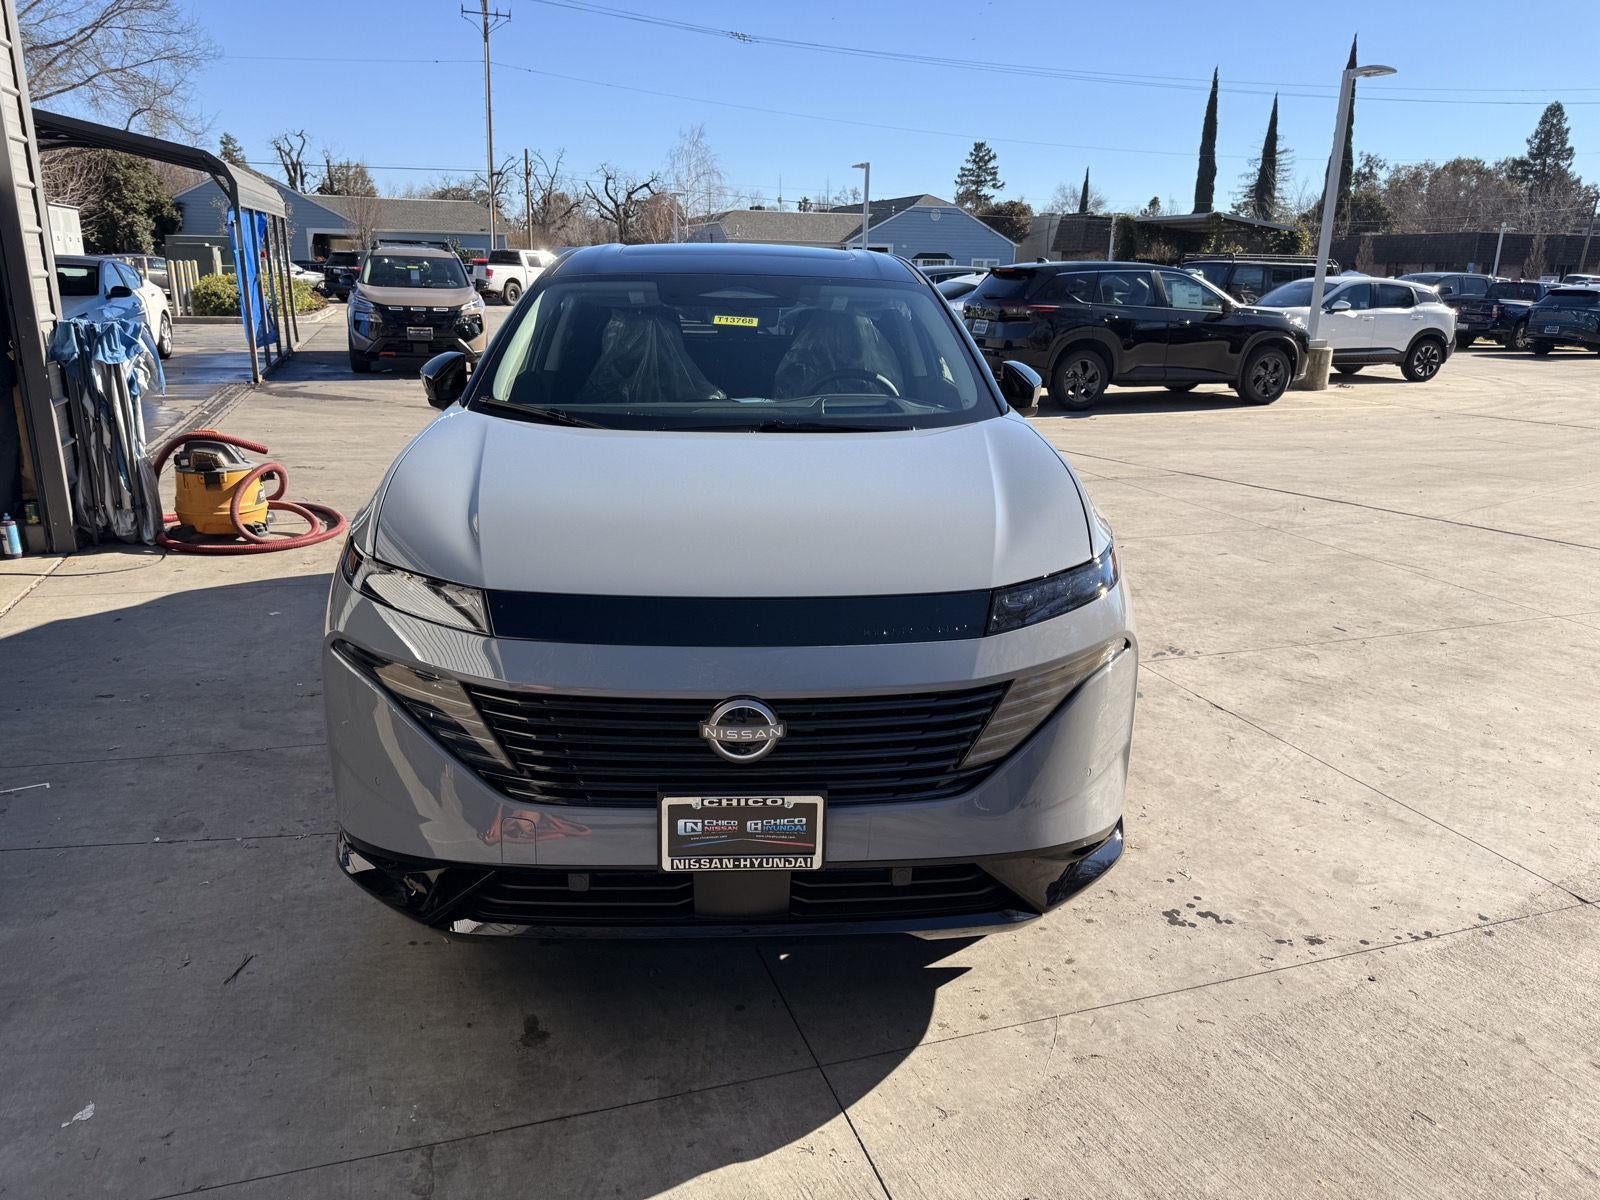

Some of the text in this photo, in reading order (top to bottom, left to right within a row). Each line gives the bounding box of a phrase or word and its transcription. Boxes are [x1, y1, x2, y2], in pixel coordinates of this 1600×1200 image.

[717, 316, 754, 324] T13768
[705, 727, 782, 739] NISSAN
[703, 798, 784, 807] CHICO
[763, 817, 807, 826] CHICO
[763, 824, 807, 832] HYUNDAI
[673, 857, 812, 869] NISSAN-HYUNDAI
